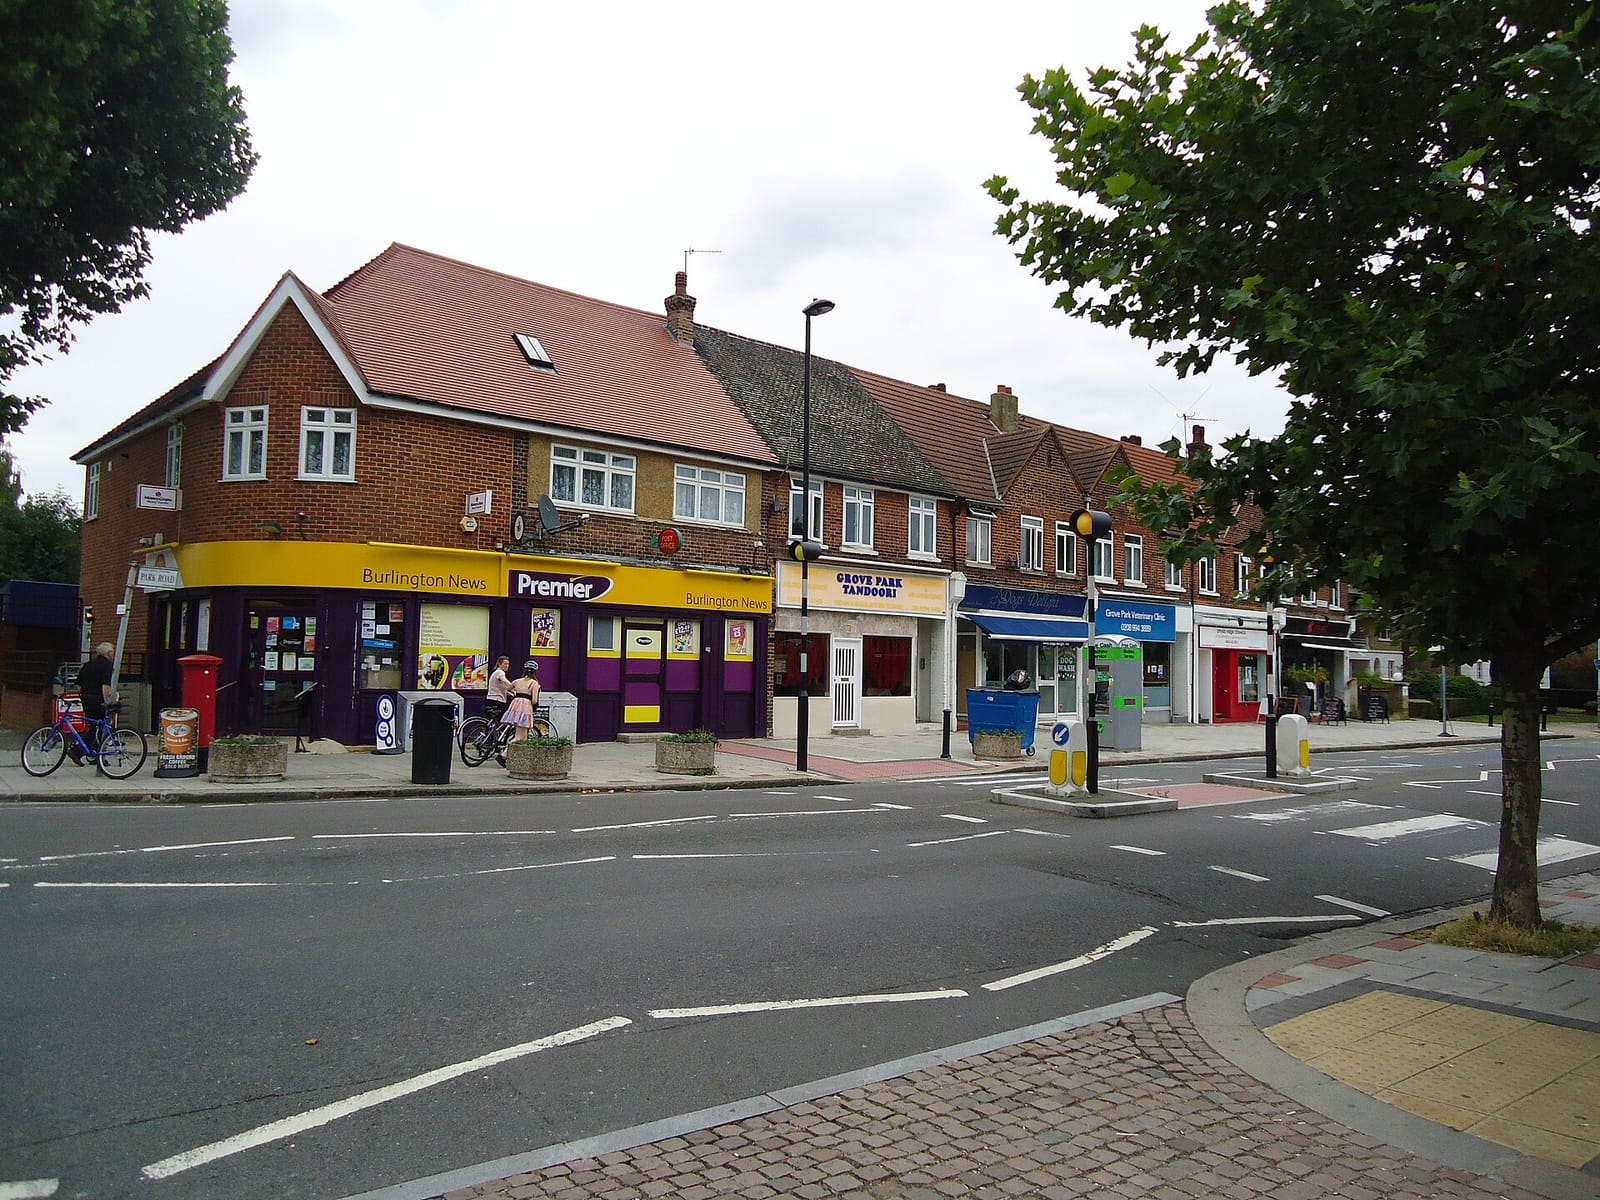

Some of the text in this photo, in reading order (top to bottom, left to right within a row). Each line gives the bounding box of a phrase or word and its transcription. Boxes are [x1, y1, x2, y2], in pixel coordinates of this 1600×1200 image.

[140, 572, 175, 583] PARK ROAD
[363, 568, 487, 590] Burlington News
[836, 573, 873, 585] GROVE
[876, 576, 903, 588] PARK
[518, 573, 593, 598] Premier
[842, 584, 897, 598] TANDOORI
[686, 592, 768, 610] Burlington News
[1105, 608, 1166, 622] Grove Park Veterinary Clinic
[1058, 664, 1075, 672] WASH
